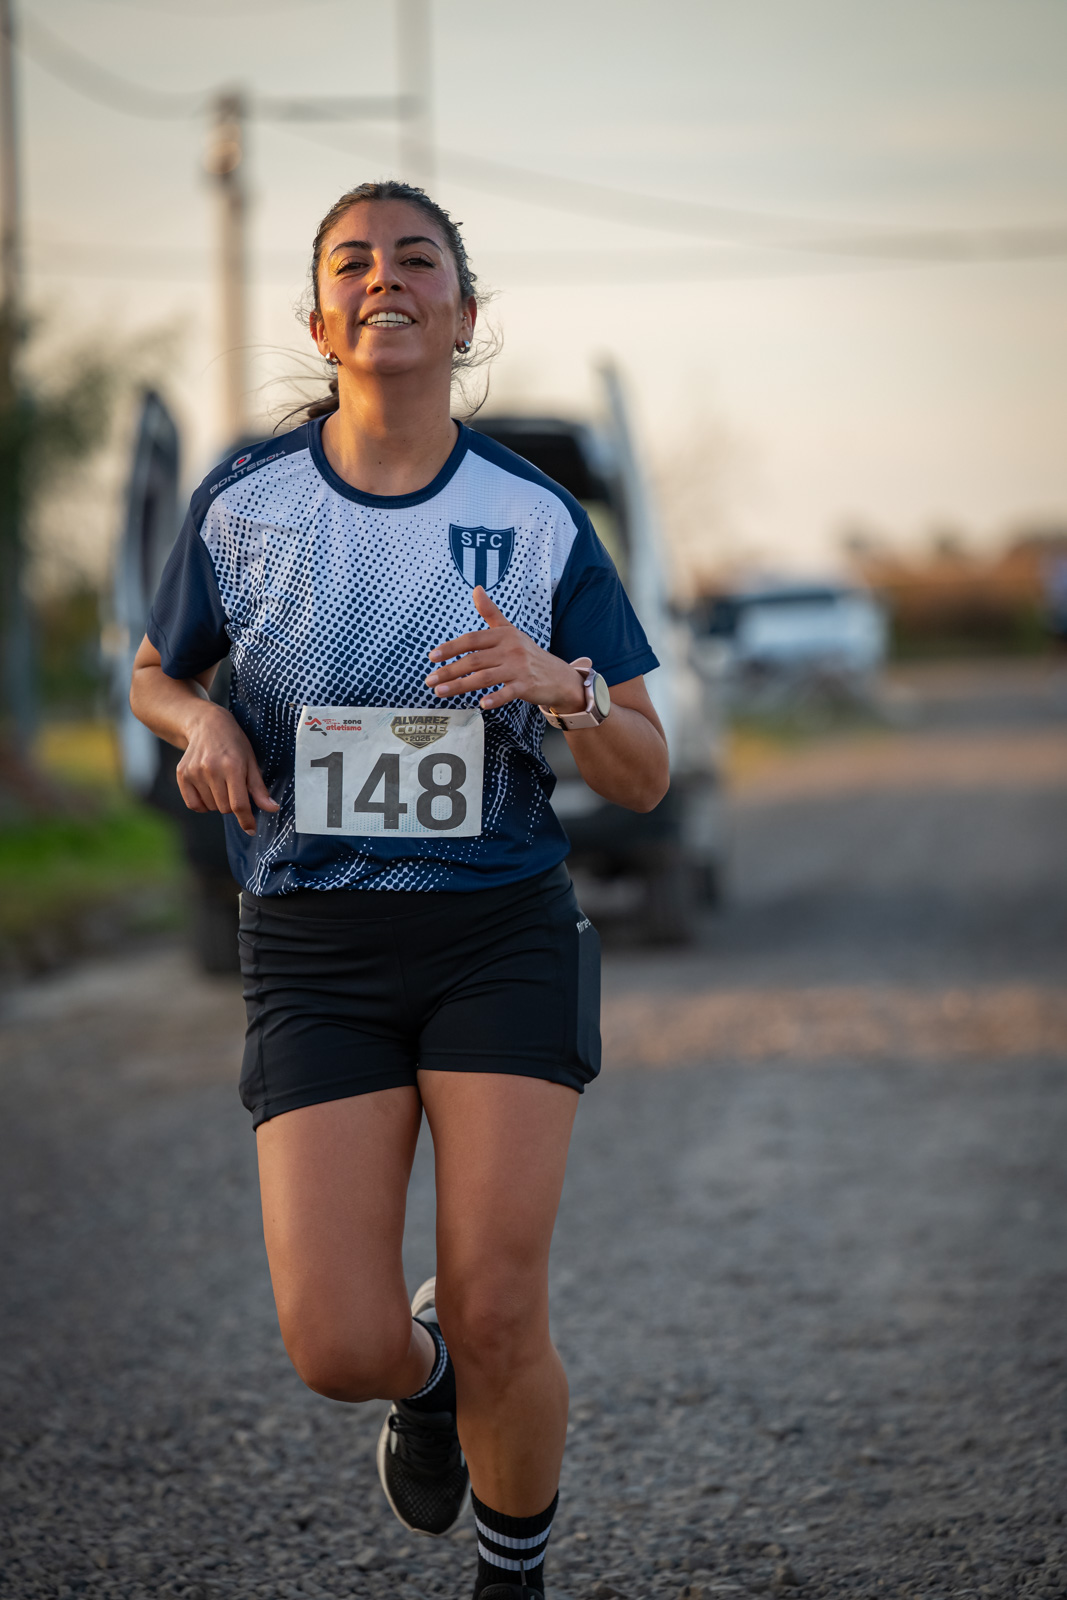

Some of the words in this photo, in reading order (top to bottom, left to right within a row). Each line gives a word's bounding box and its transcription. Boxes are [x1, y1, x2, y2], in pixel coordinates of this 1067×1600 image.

[460, 531, 503, 549] SFC
[392, 716, 450, 725] ALVAREZ
[394, 724, 446, 735] CORRE
[310, 751, 467, 831] 148
